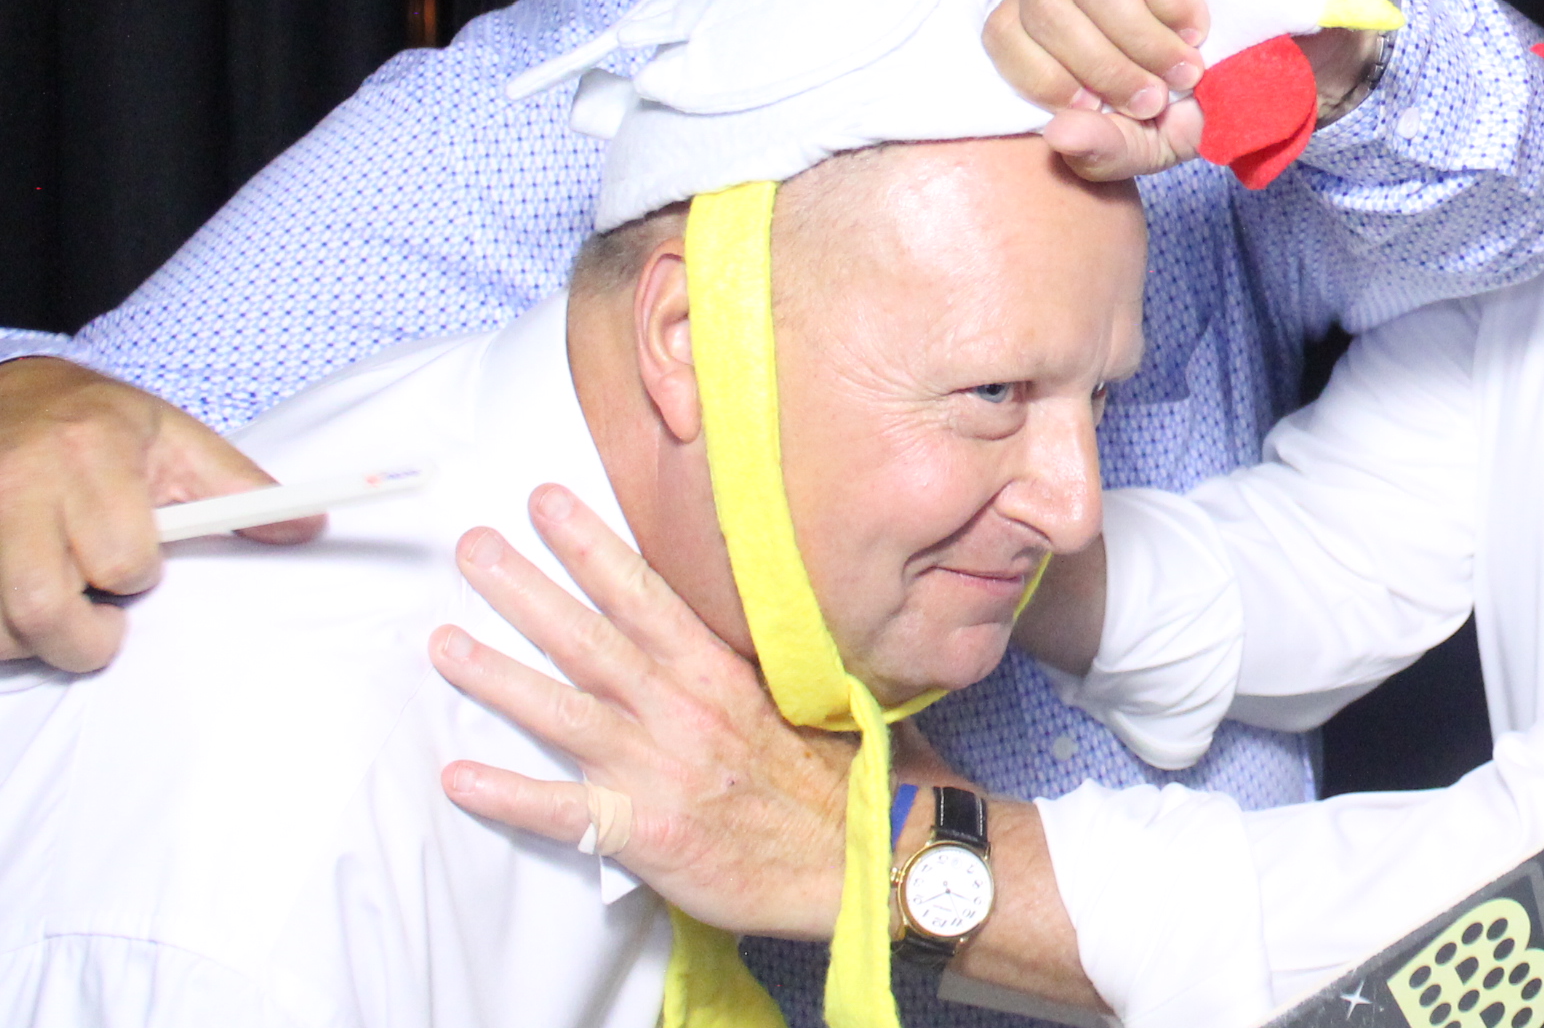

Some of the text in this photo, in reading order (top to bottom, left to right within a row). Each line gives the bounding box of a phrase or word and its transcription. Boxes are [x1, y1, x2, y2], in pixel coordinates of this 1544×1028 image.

[971, 878, 983, 889] 8
[922, 909, 930, 917] 1
[962, 908, 976, 919] 10
[931, 916, 948, 928] 12
[950, 917, 963, 927] 11
